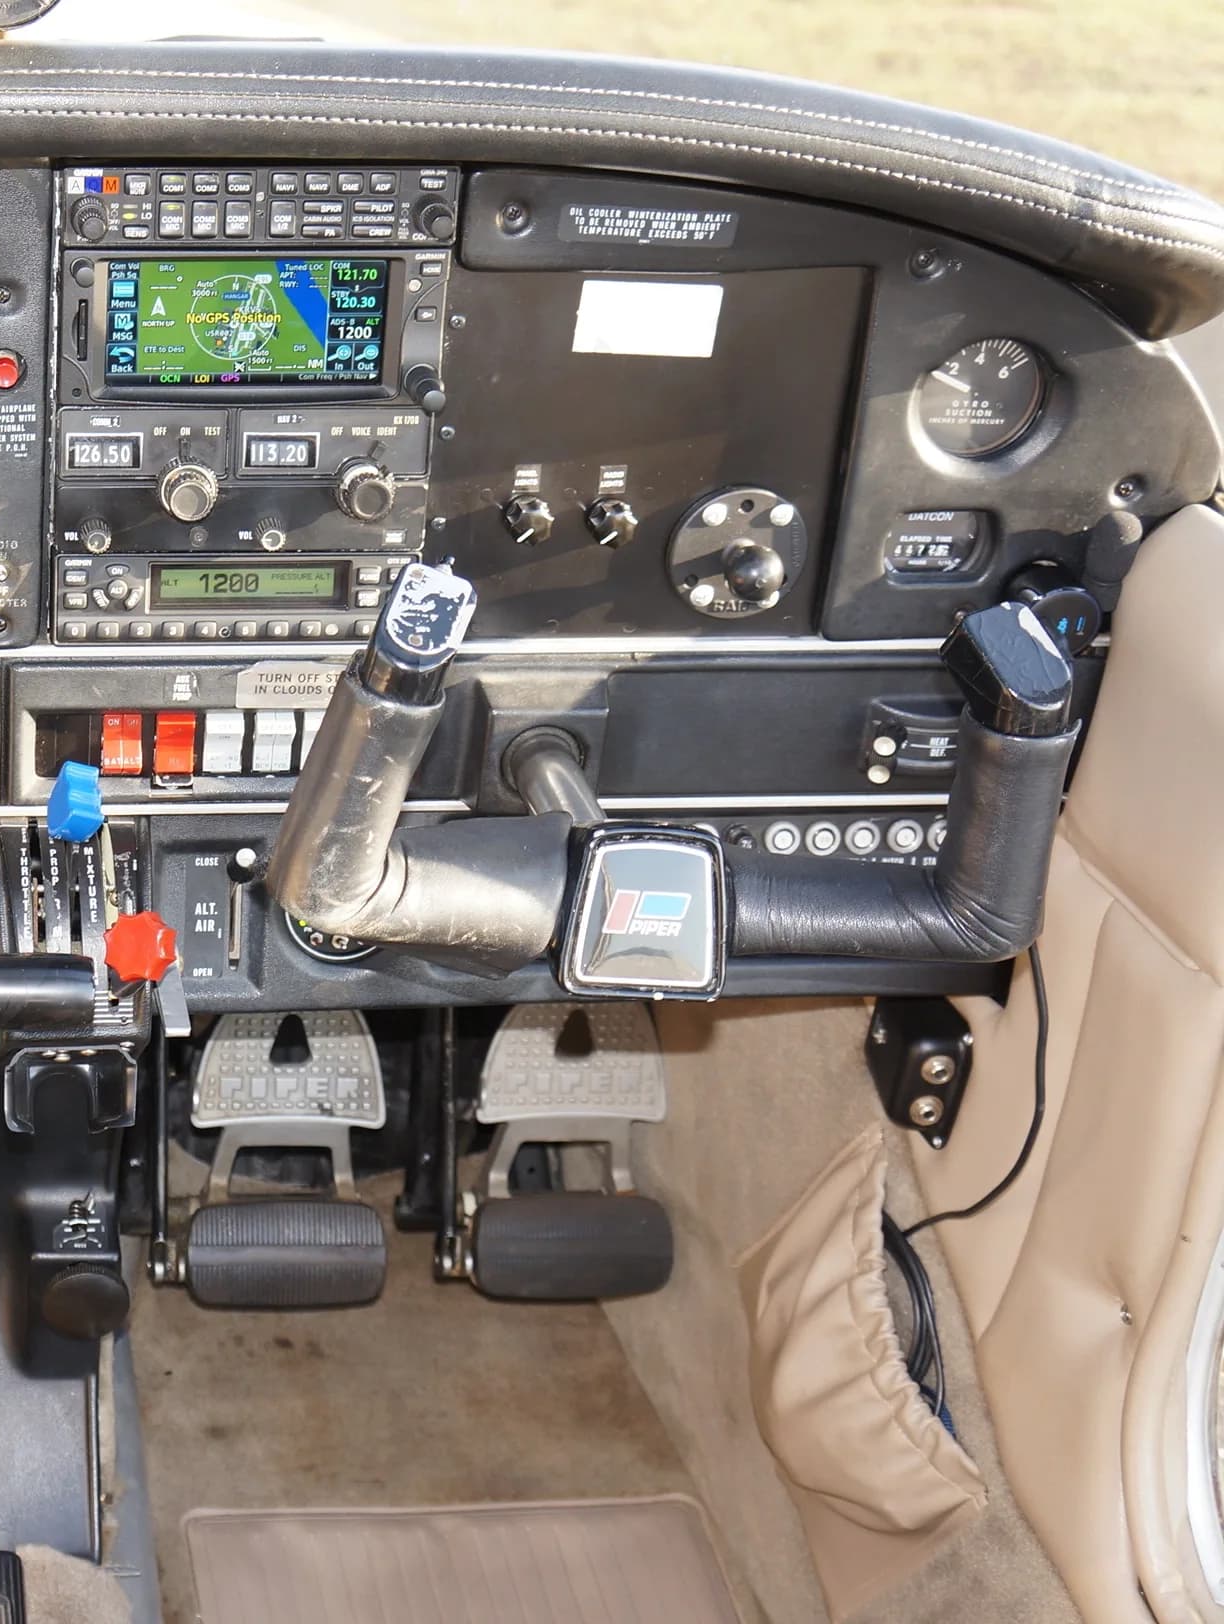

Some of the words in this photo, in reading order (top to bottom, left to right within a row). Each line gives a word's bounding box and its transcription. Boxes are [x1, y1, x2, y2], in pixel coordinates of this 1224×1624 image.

[163, 185, 184, 193] COM1
[195, 185, 217, 193] COM2
[228, 185, 250, 193] COM3
[276, 184, 295, 192] NAV1
[309, 184, 328, 192] NAV2
[342, 184, 360, 192] DME
[375, 183, 391, 192] ADF
[320, 205, 342, 213] SPKR
[370, 204, 394, 212] PILOT
[141, 212, 152, 220] LO
[569, 207, 583, 216] OIL
[589, 208, 621, 218] COOLER
[628, 210, 697, 222] WINTERIZATION
[705, 214, 731, 223] PLATE
[161, 216, 183, 224] COM1
[193, 216, 216, 224] COM2
[226, 216, 249, 224] COM3
[575, 217, 584, 225] TO
[589, 217, 599, 226] BE
[605, 218, 645, 228] REMOVED
[652, 220, 676, 229] WHEN
[682, 222, 720, 231] AMBIENT
[369, 228, 392, 236] CREW
[158, 264, 175, 272] BRG
[285, 263, 307, 271] Tuned
[309, 263, 324, 271] LOC
[333, 262, 350, 270] COM
[336, 269, 378, 281] 121.70
[197, 280, 214, 288] Auto
[331, 291, 349, 299] STBY
[111, 300, 136, 308] Menu
[335, 296, 376, 308] 120.30
[186, 312, 201, 324] No
[206, 312, 229, 324] GPS
[233, 311, 282, 324] Position
[366, 318, 379, 326] ALT
[112, 332, 134, 341] MSG
[338, 326, 373, 340] 1200
[293, 344, 307, 352] DIS
[975, 353, 984, 365] 4
[111, 364, 134, 373] Back
[307, 359, 323, 369] NM
[334, 363, 343, 371] In
[357, 362, 375, 371] Out
[950, 363, 959, 375] 2
[998, 366, 1009, 379] 6
[160, 374, 181, 383] OCN
[194, 375, 210, 383] LOI
[220, 374, 240, 383] GPS
[1, 404, 36, 413] AIRPLANE
[952, 400, 989, 408] GYRO
[945, 408, 992, 417] SUCTION
[18, 414, 36, 422] WITH
[929, 417, 955, 425] INCHES
[153, 427, 167, 436] OFF
[180, 427, 191, 436] ON
[204, 427, 221, 436] TEST
[331, 427, 343, 436] OFF
[351, 427, 371, 436] VOICE
[377, 427, 397, 436] IDENT
[10, 433, 36, 442] SYSTEM
[75, 444, 131, 463] 126.50
[250, 443, 307, 463] 113.20
[908, 512, 954, 521] DATCON
[65, 531, 79, 541] VOL
[239, 531, 253, 540] VOL
[271, 572, 313, 580] PRESSURE
[315, 572, 331, 580] ALT
[199, 573, 260, 594] 1200
[259, 673, 292, 683] TURN
[298, 673, 320, 683] OFF
[254, 685, 266, 695] IN
[273, 685, 322, 695] CLOUDS
[195, 857, 219, 867] CLOSE
[49, 848, 60, 886] PROP
[83, 846, 98, 923] MIXTURE
[194, 902, 218, 916] ALT.
[194, 919, 215, 932] AIR
[628, 919, 682, 937] PIPER
[193, 968, 213, 977] OPEN
[220, 1076, 360, 1100] PIPER
[512, 1071, 642, 1096] PIPER
